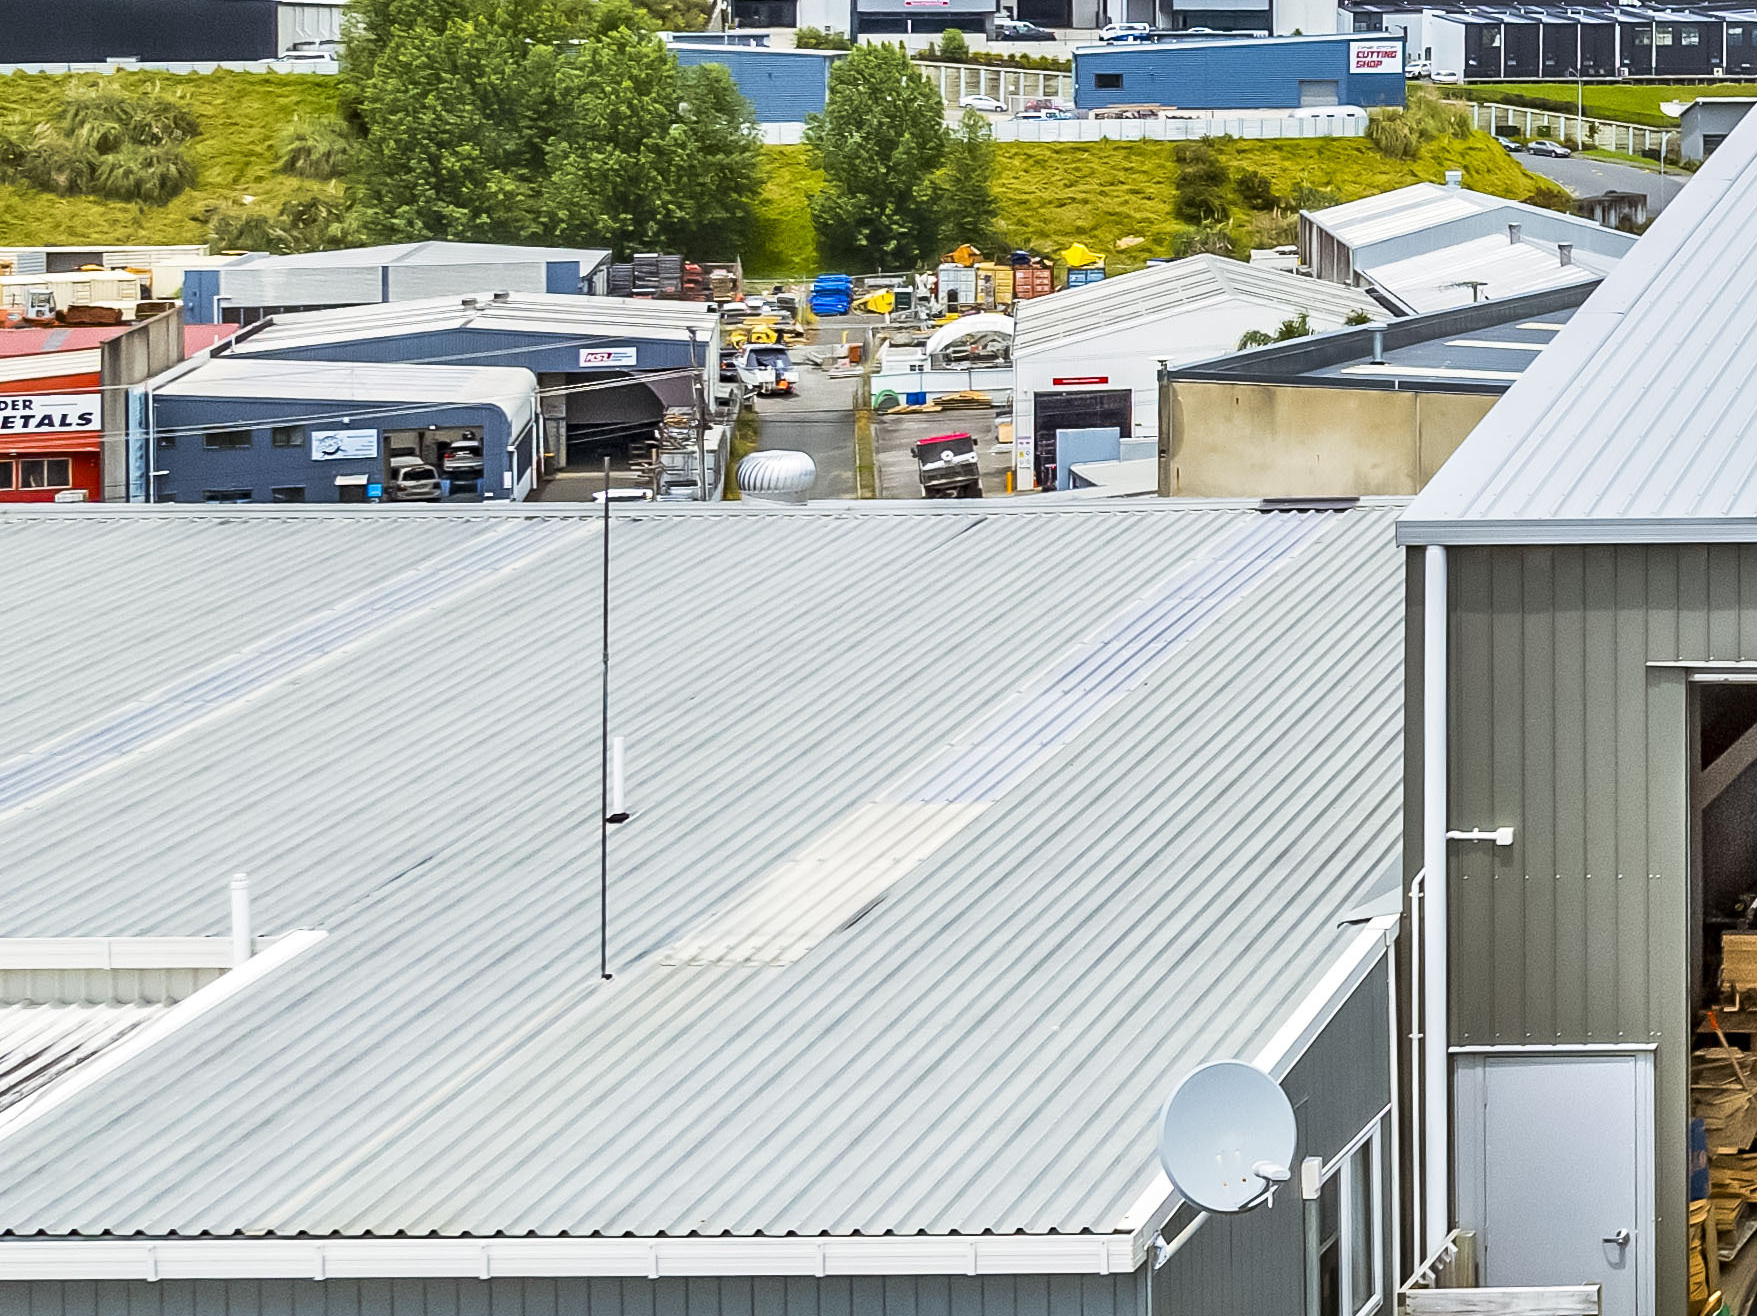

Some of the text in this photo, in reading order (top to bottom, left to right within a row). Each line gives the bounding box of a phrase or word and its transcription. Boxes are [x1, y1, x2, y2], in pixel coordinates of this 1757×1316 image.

[1356, 50, 1398, 59] CUTTING
[1355, 60, 1383, 69] SHOP
[0, 412, 94, 430] ETALS
